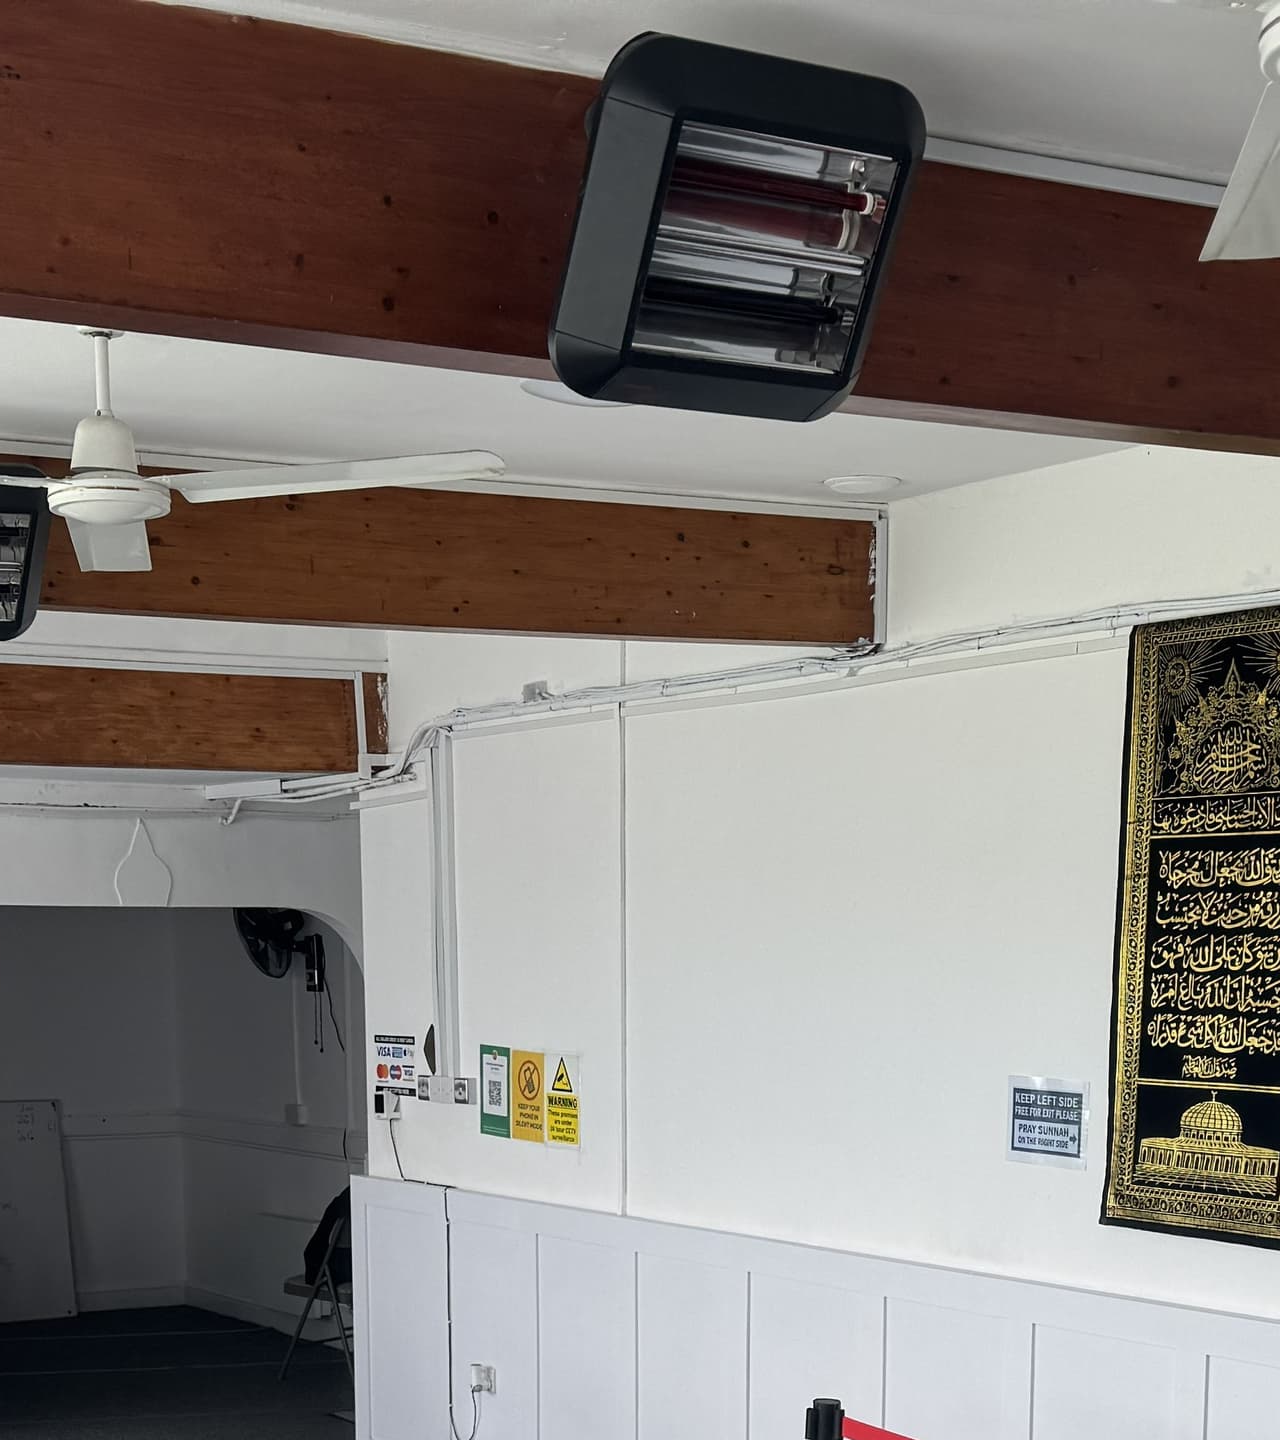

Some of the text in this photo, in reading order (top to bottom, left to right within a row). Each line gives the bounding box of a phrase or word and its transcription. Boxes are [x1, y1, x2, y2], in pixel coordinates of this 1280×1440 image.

[377, 1046, 391, 1057] VISA
[547, 1096, 577, 1108] WARNING
[1015, 1093, 1079, 1107] KEEP LEFT SIDE
[1015, 1106, 1029, 1116] FREE
[1030, 1107, 1041, 1117] FOR
[1043, 1108, 1055, 1119] EXIT
[1018, 1123, 1069, 1137] PRAY SUNNAH
[1018, 1136, 1068, 1149] ON THE RIGHT SIDE
